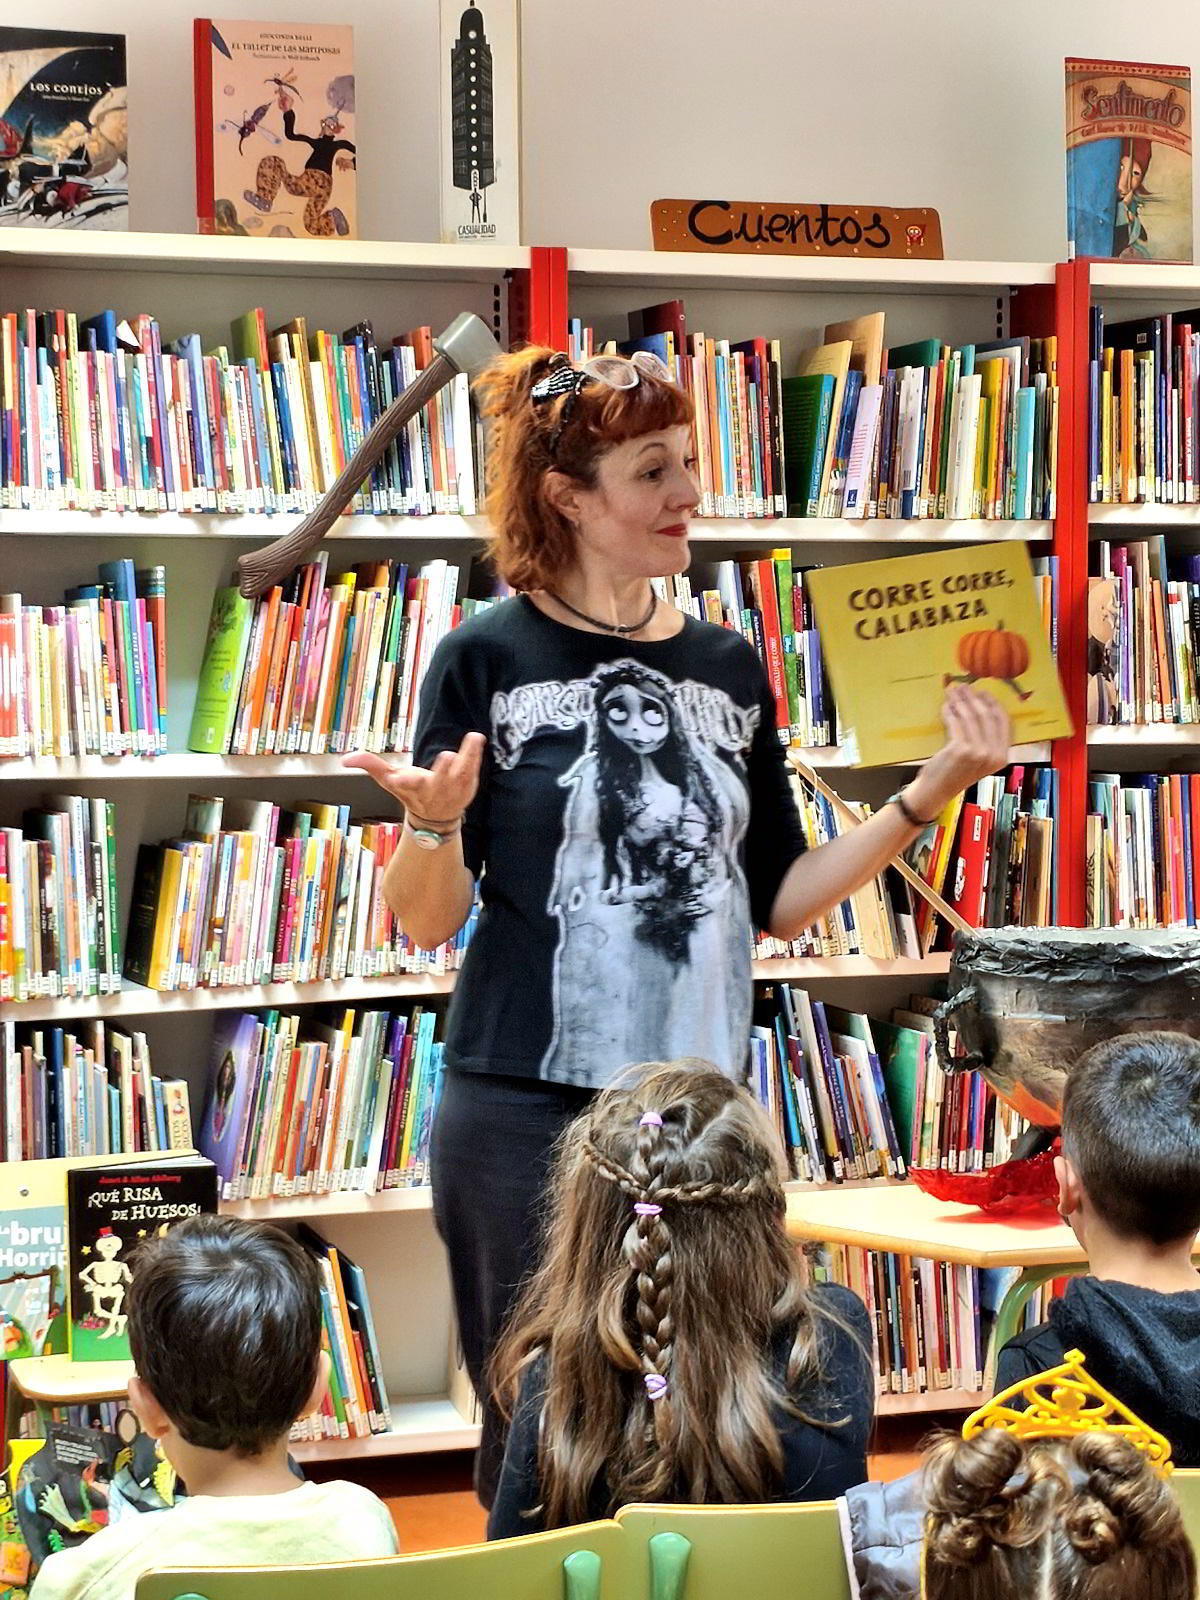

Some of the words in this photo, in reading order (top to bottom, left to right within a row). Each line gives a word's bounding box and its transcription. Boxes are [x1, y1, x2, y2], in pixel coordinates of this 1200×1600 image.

[687, 199, 891, 248] Cuentos
[848, 579, 934, 612] CORRE
[940, 569, 1016, 595] CORRE,
[855, 598, 989, 640] CALABAZA
[87, 1188, 121, 1208] ¡QUÉ
[123, 1186, 163, 1203] RISA
[111, 1209, 129, 1221] DE
[130, 1203, 201, 1220] HUESOS!
[10, 1220, 62, 1246] bru
